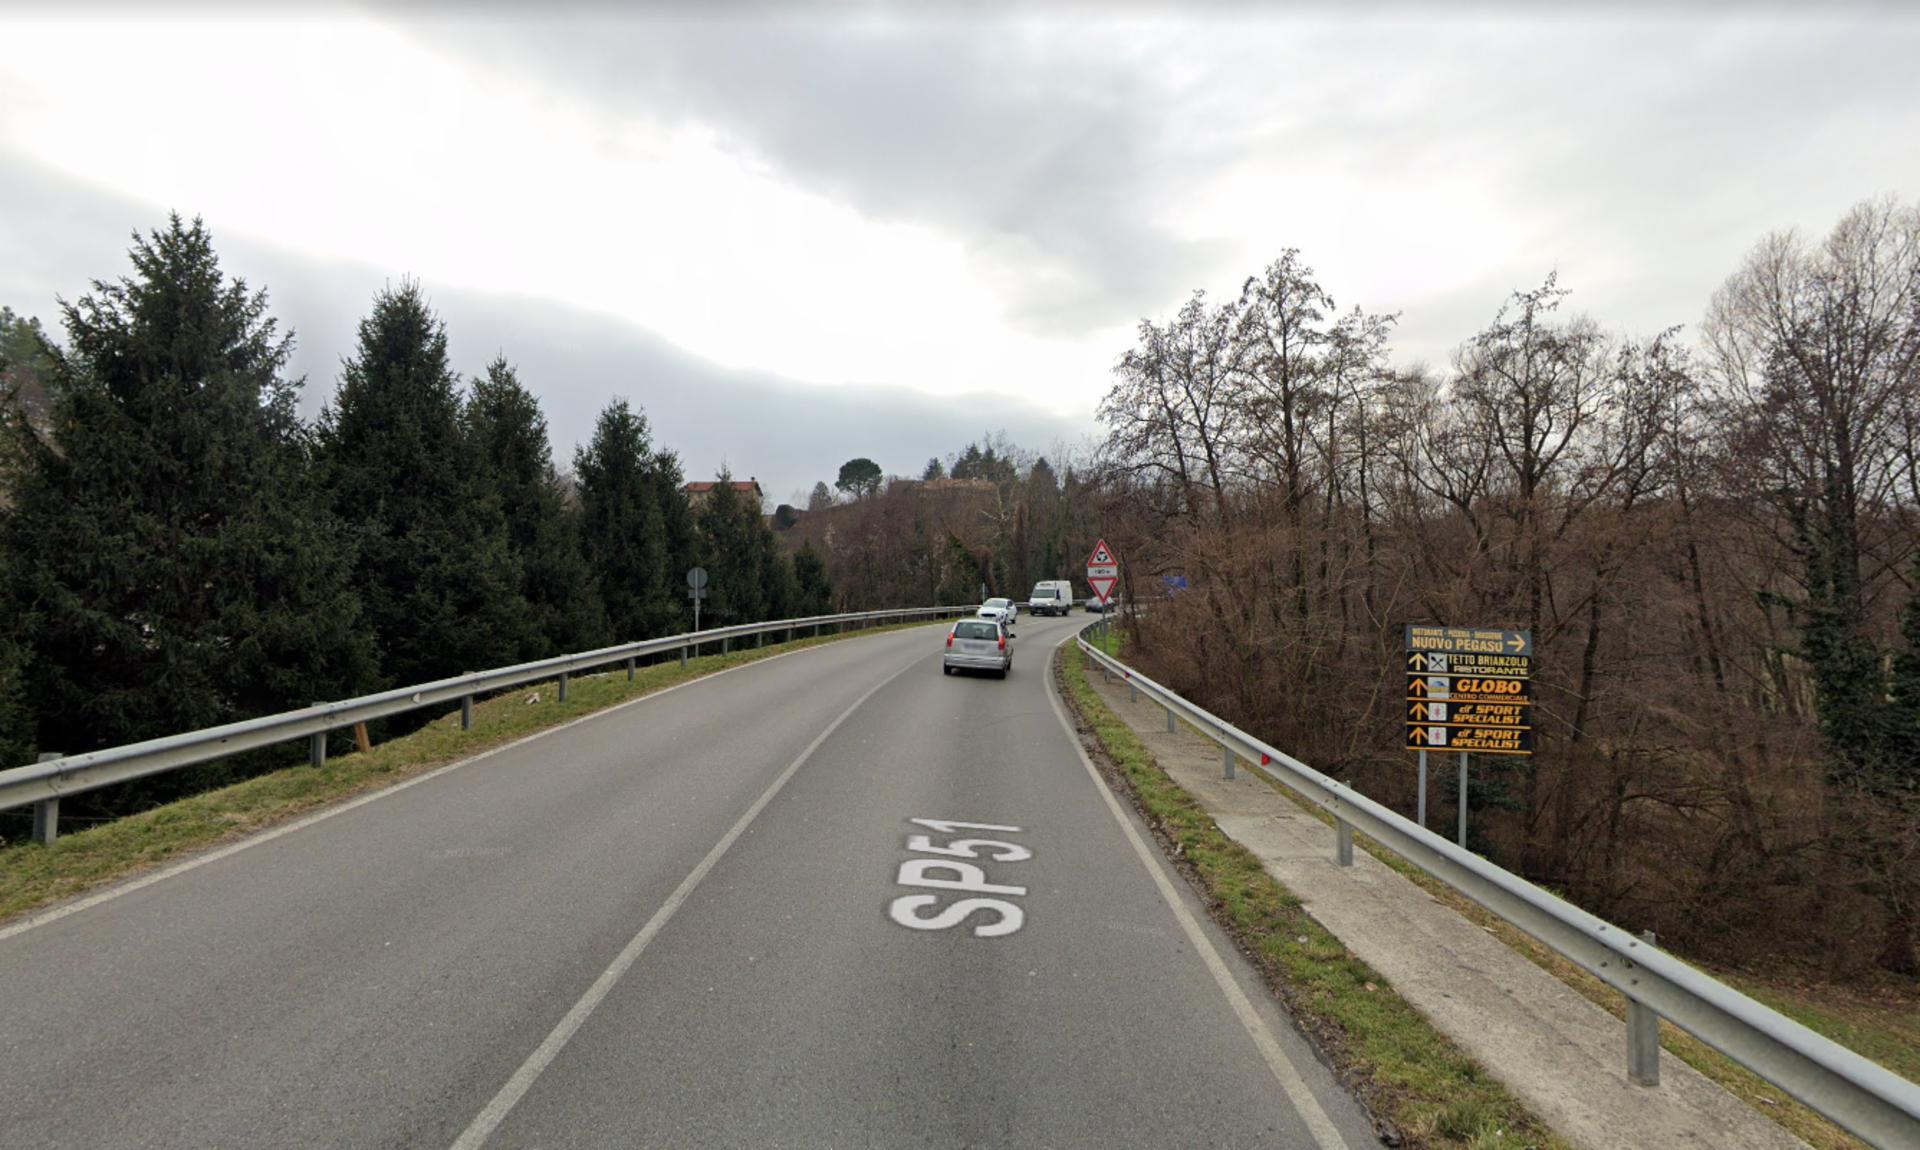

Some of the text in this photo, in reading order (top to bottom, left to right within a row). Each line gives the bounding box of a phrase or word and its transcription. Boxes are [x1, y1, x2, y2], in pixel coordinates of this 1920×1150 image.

[1411, 637, 1452, 649] NUOVO
[1448, 654, 1528, 667] TETTO BRIANZOLO
[1453, 665, 1528, 675] RISTORANTE
[1456, 679, 1522, 694] GLOBO
[1476, 705, 1522, 715] SPORT
[1453, 714, 1522, 724] SPECIALIST
[1474, 730, 1522, 740] SPORT
[1451, 738, 1522, 749] SPECIALIST
